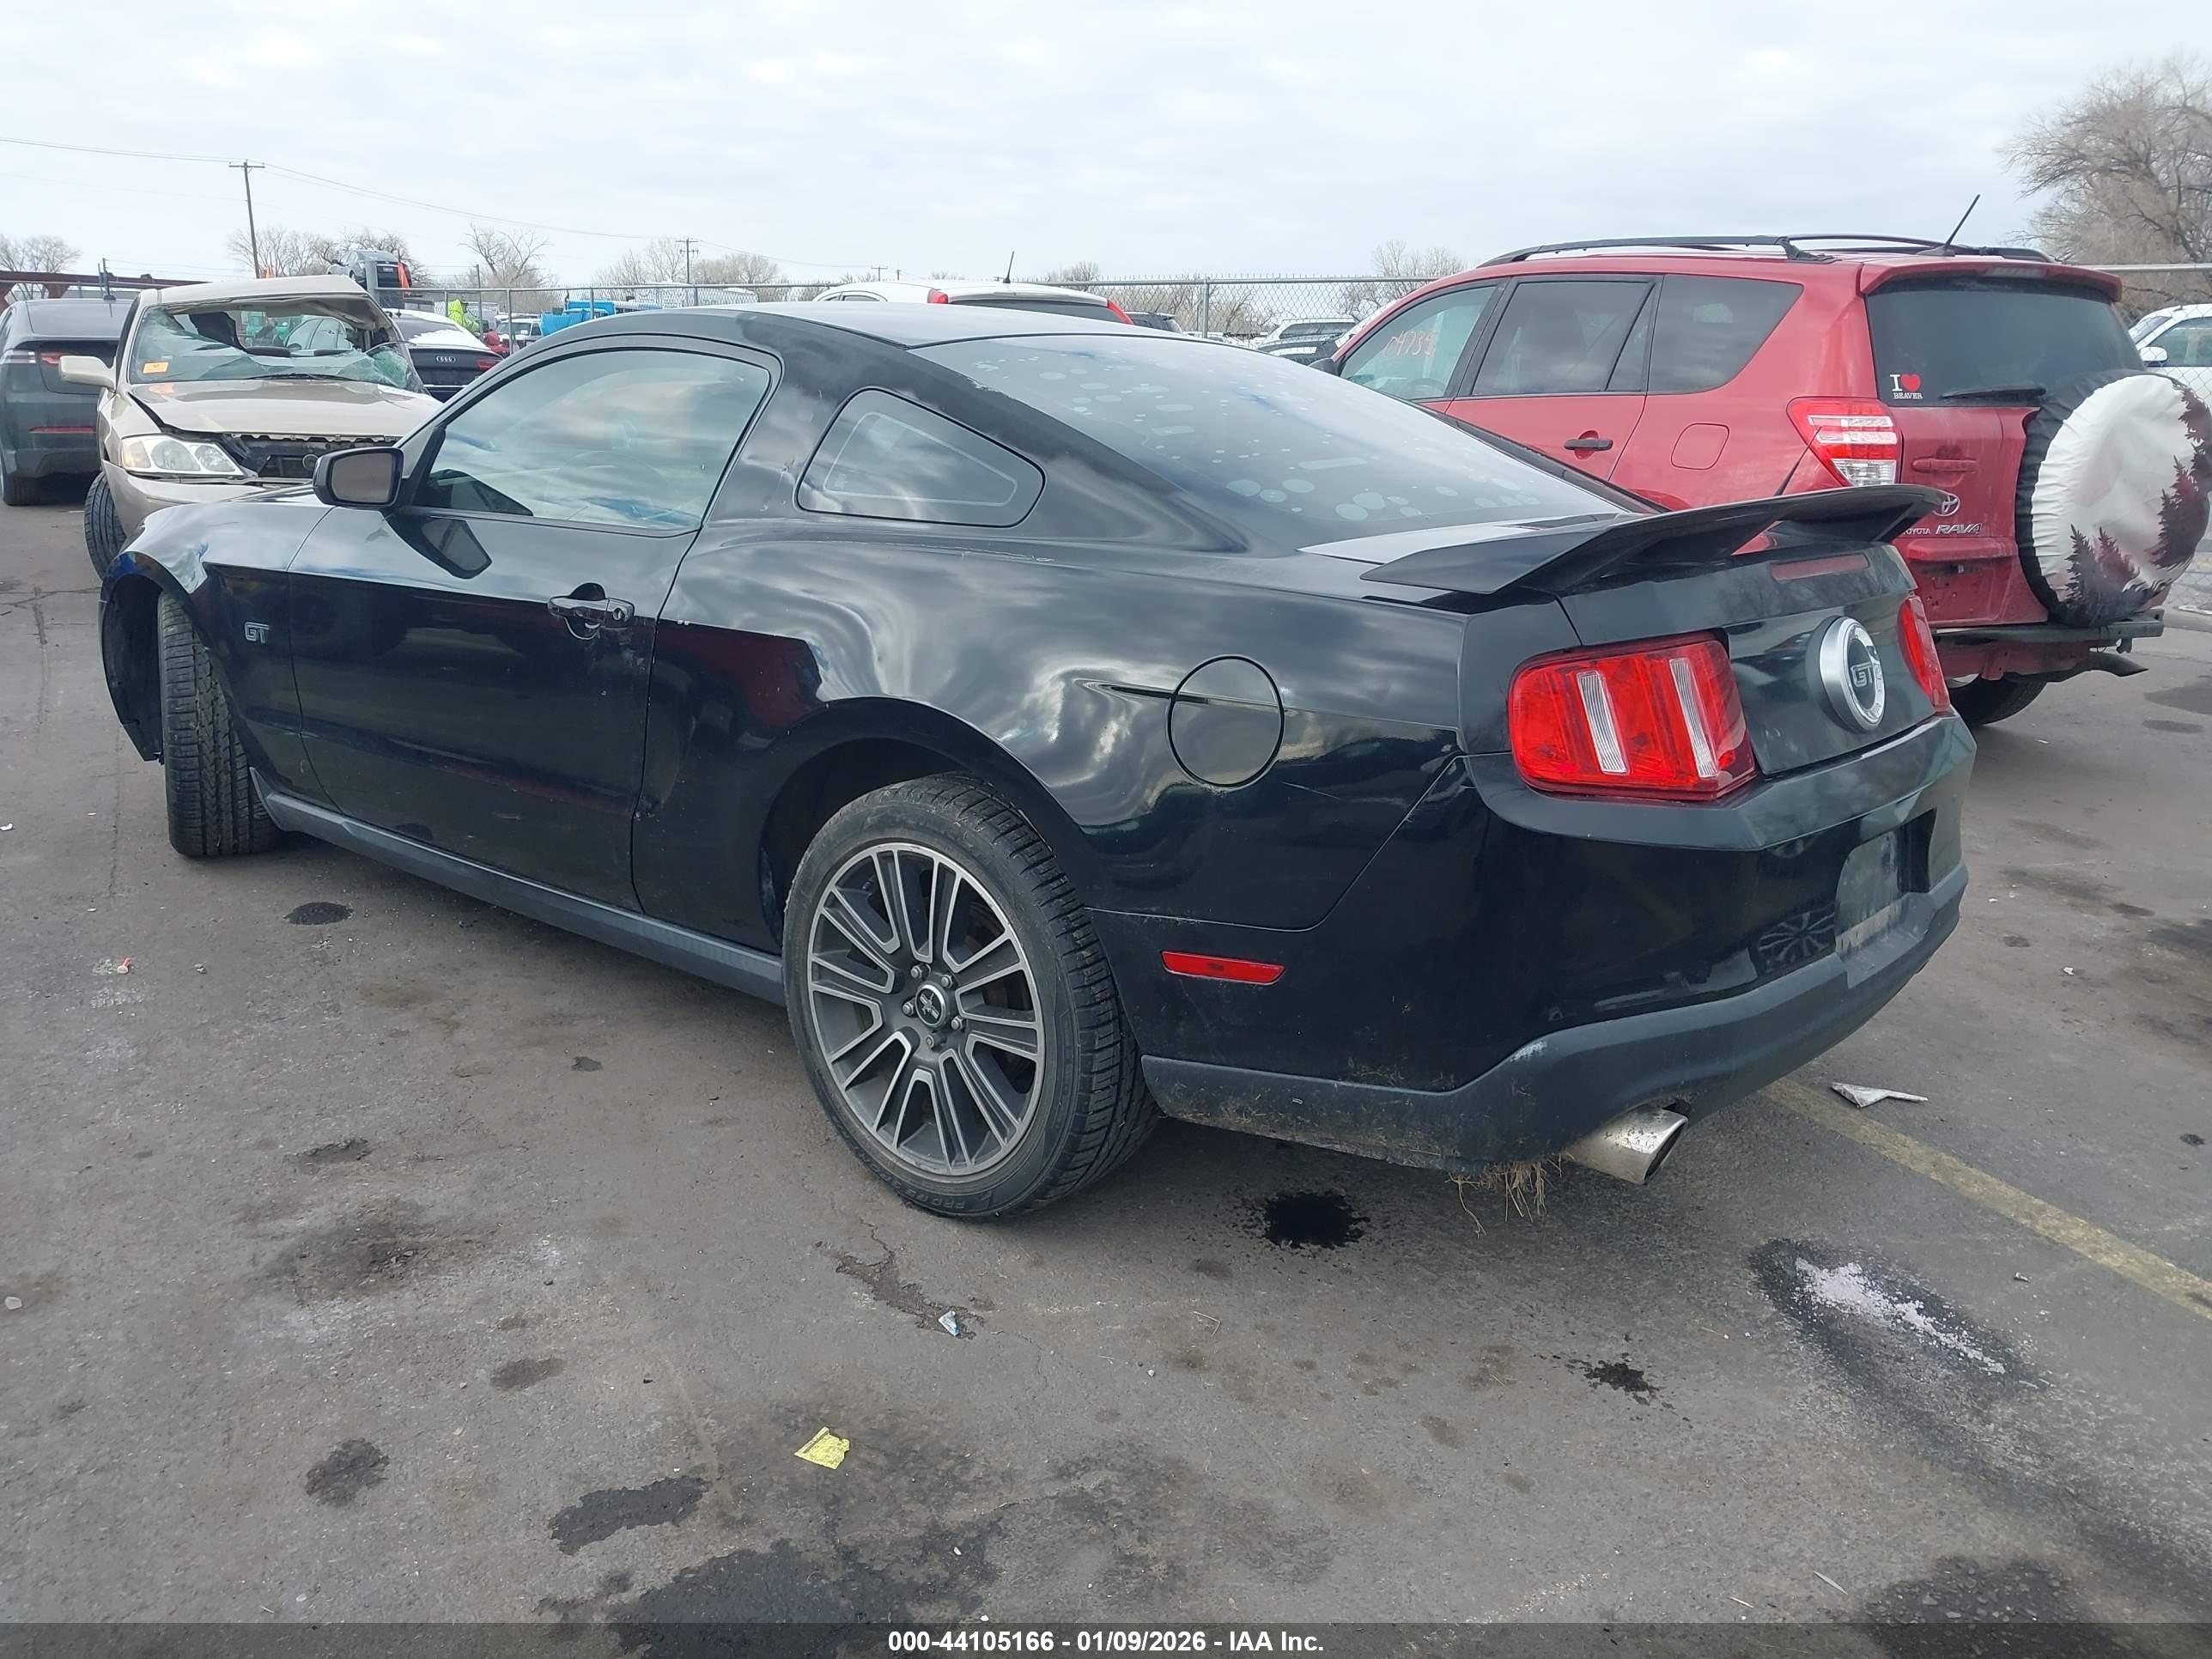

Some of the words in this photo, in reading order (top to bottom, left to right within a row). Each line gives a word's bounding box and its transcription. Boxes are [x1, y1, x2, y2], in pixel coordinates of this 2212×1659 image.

[1890, 374, 1901, 392] I
[1936, 523, 1982, 535] RAV4
[245, 622, 270, 644] GT
[1850, 661, 1873, 688] GT
